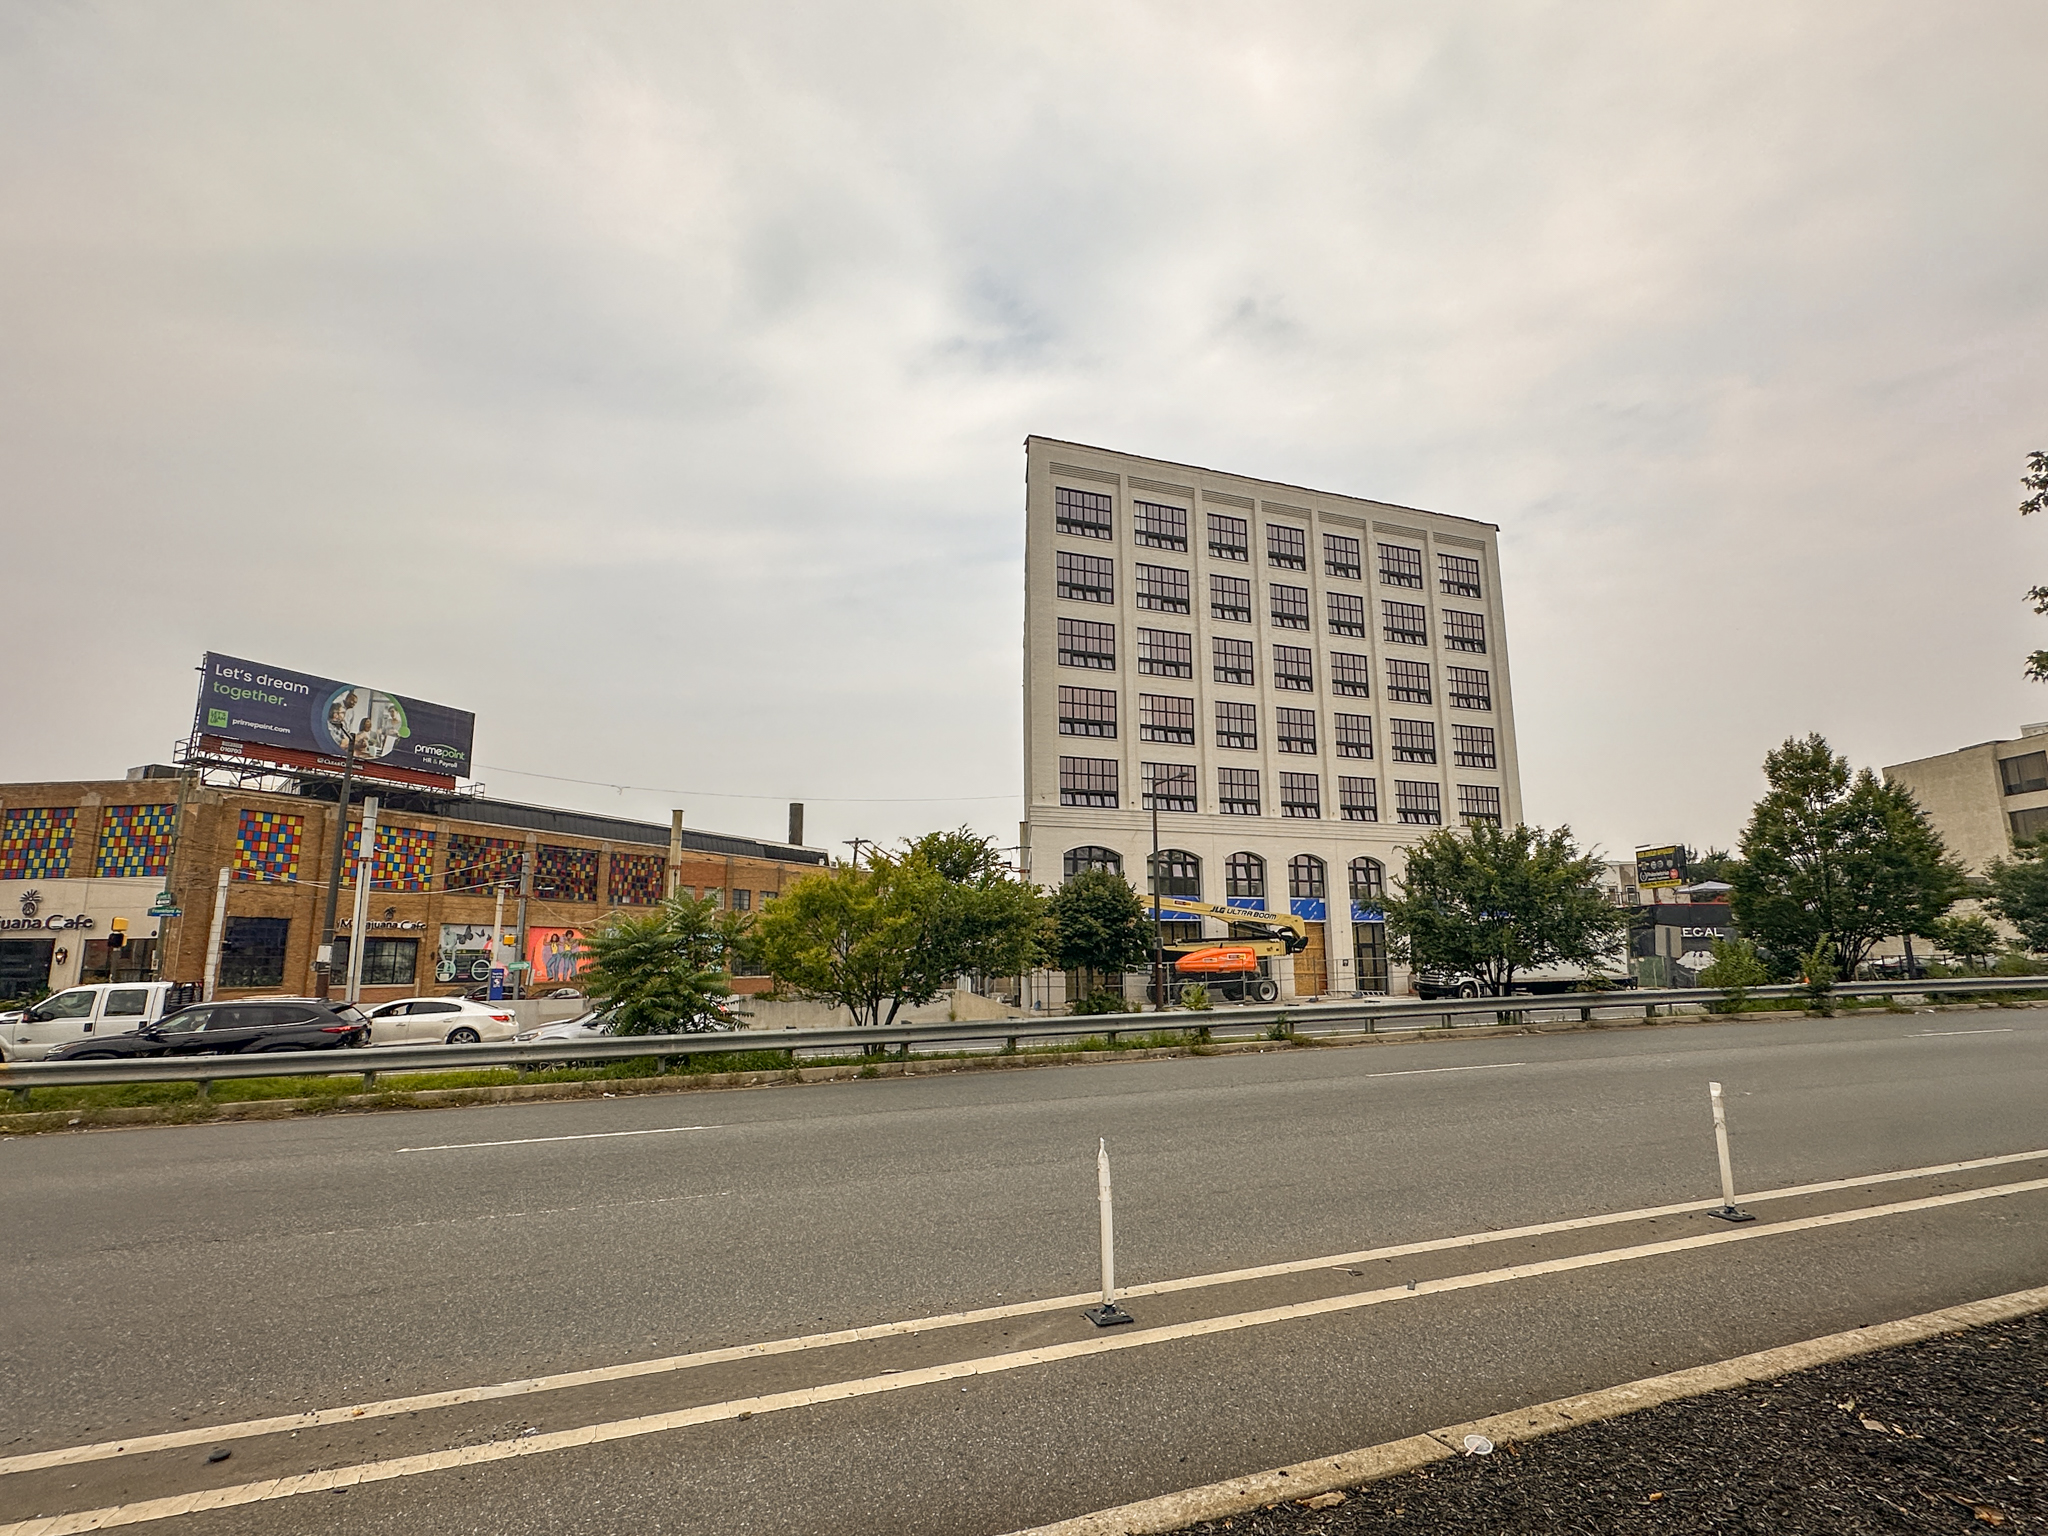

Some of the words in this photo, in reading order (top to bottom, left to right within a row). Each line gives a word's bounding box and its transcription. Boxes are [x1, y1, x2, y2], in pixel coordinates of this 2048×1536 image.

[215, 664, 252, 682] Let's
[256, 674, 309, 695] dream
[213, 681, 288, 706] together.
[232, 719, 291, 734] primepoint.com
[414, 744, 465, 760] primepoint
[438, 760, 458, 768] Payroll
[1210, 905, 1226, 914] JLG
[1226, 908, 1252, 917] ULTRA
[1253, 911, 1277, 920] BOOM
[45, 914, 94, 931] Cafe
[400, 920, 426, 930] Cafe
